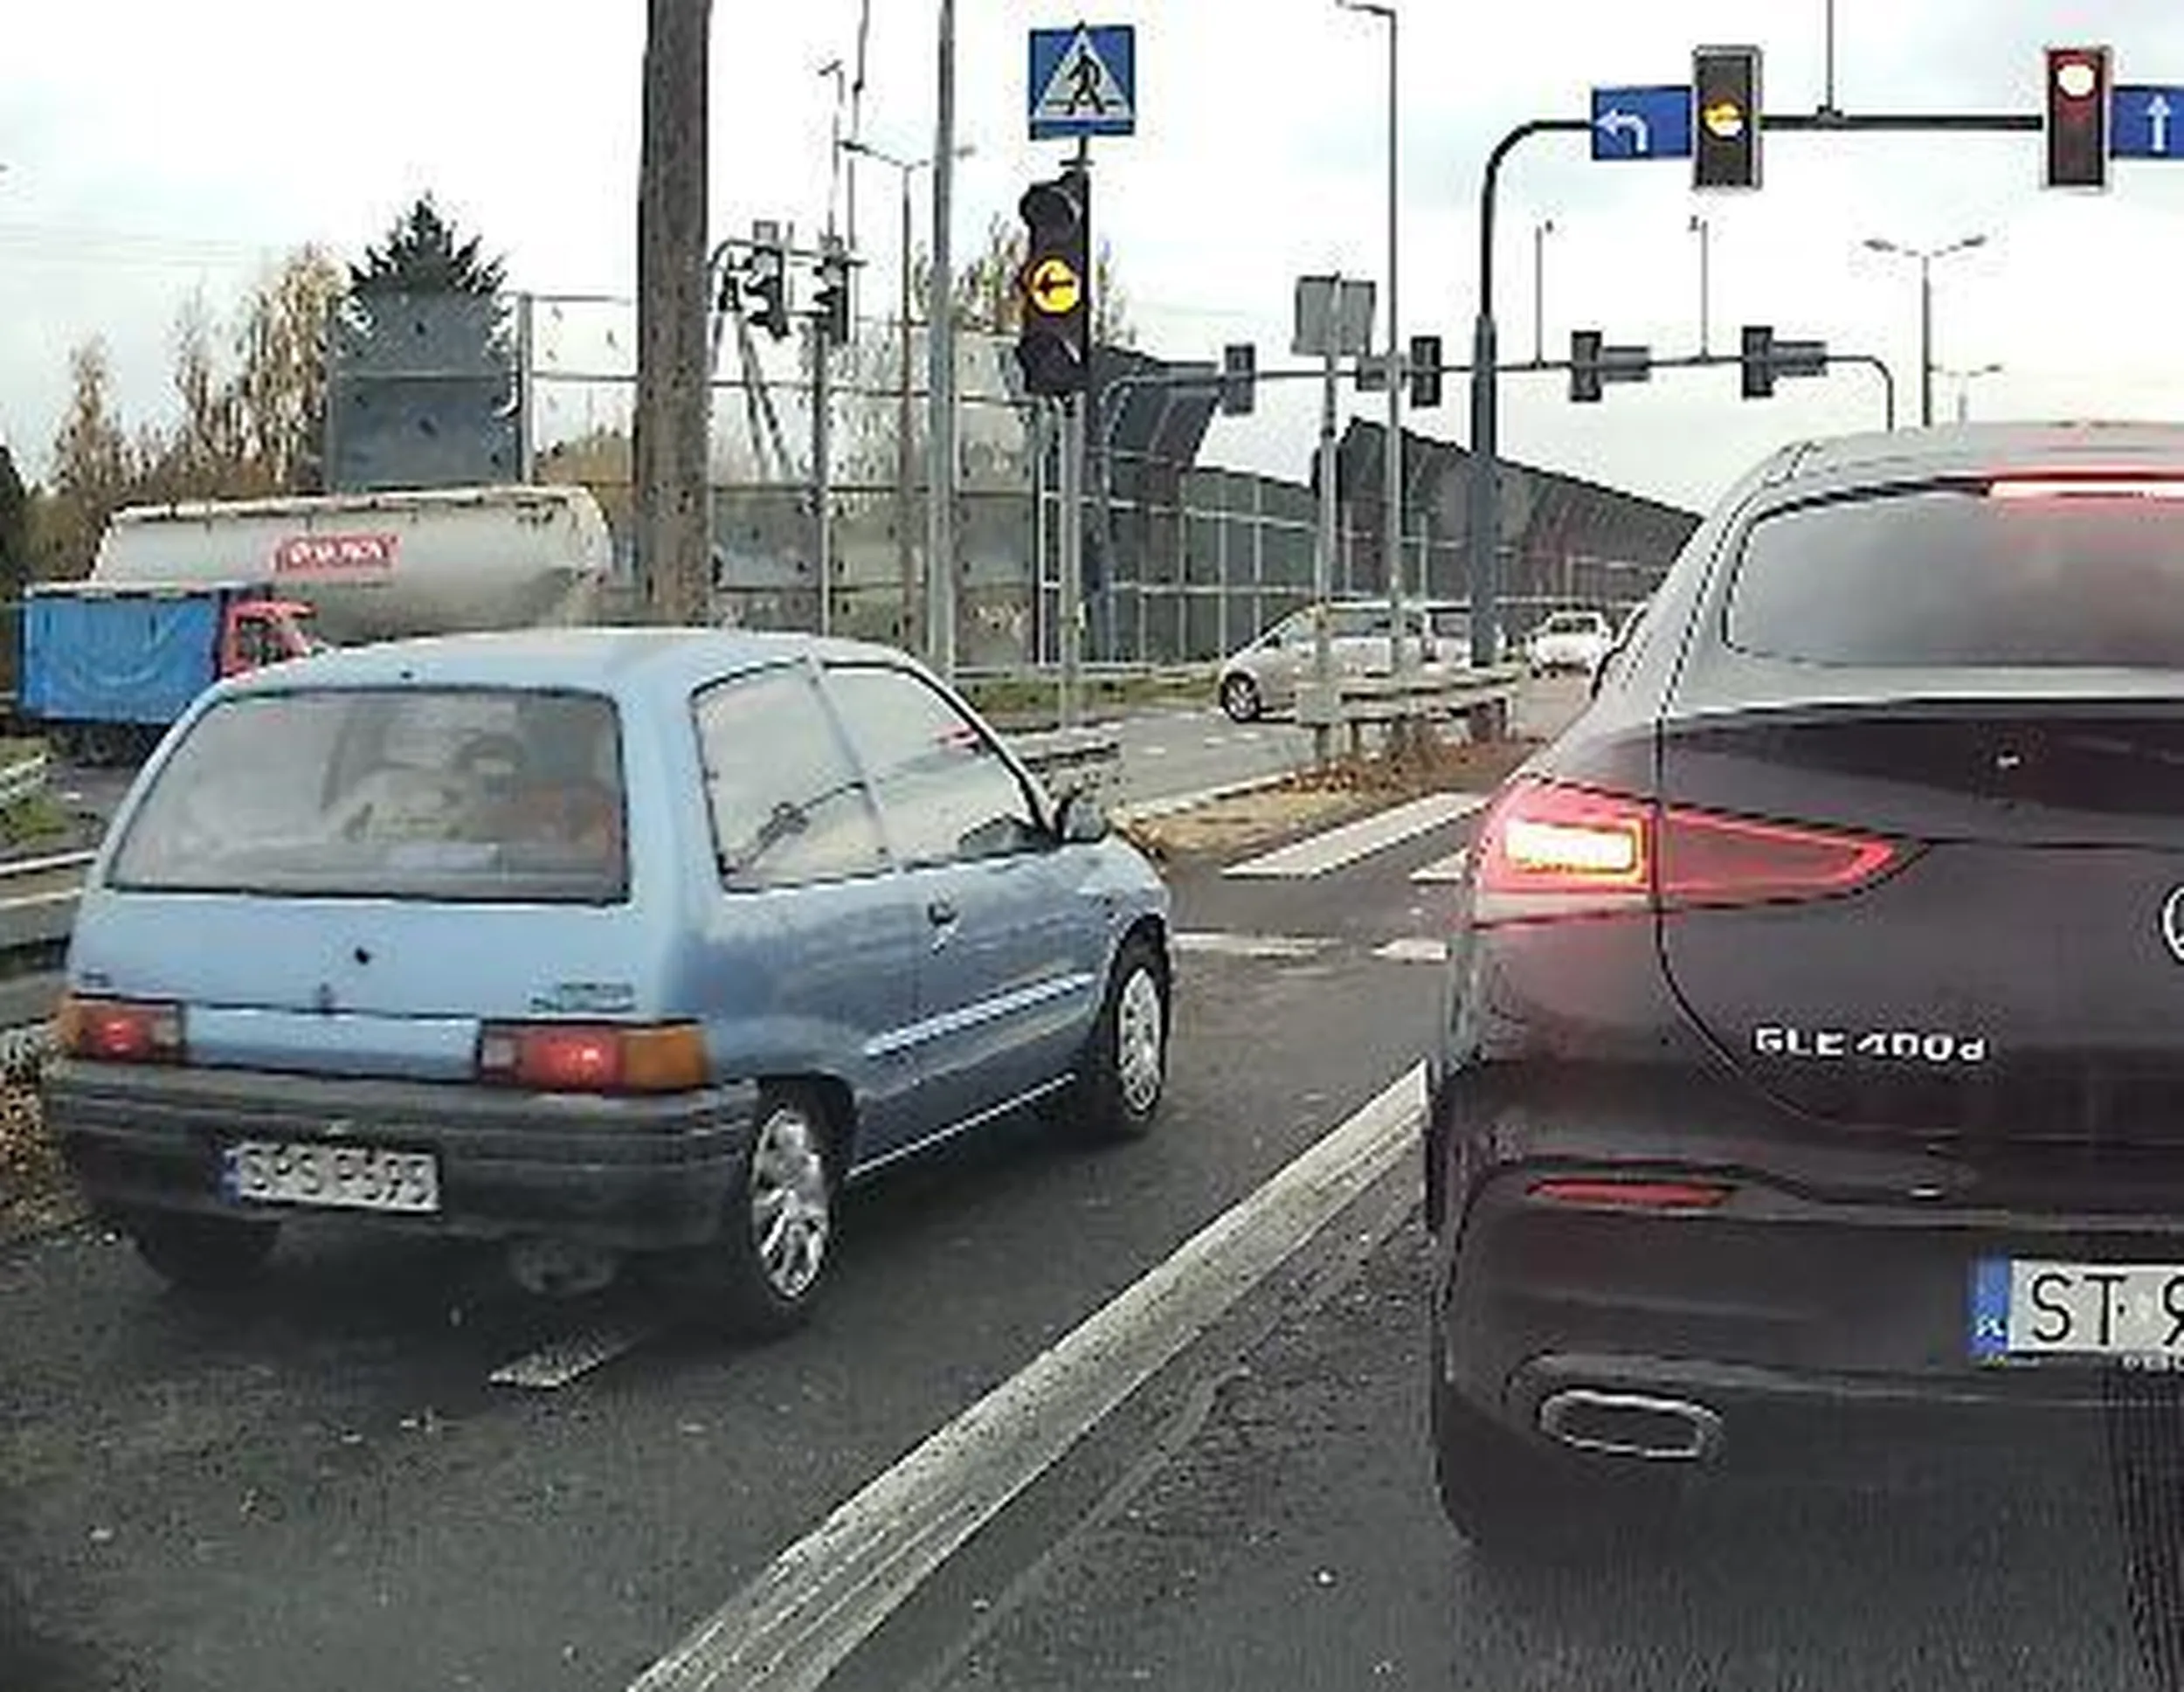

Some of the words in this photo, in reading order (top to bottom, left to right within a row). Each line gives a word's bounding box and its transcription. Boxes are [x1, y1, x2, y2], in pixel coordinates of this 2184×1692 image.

[1755, 1028, 1846, 1055] GLE
[1856, 1032, 1986, 1061] 400d
[243, 1146, 321, 1195] SPS
[2031, 1273, 2127, 1346] ST
